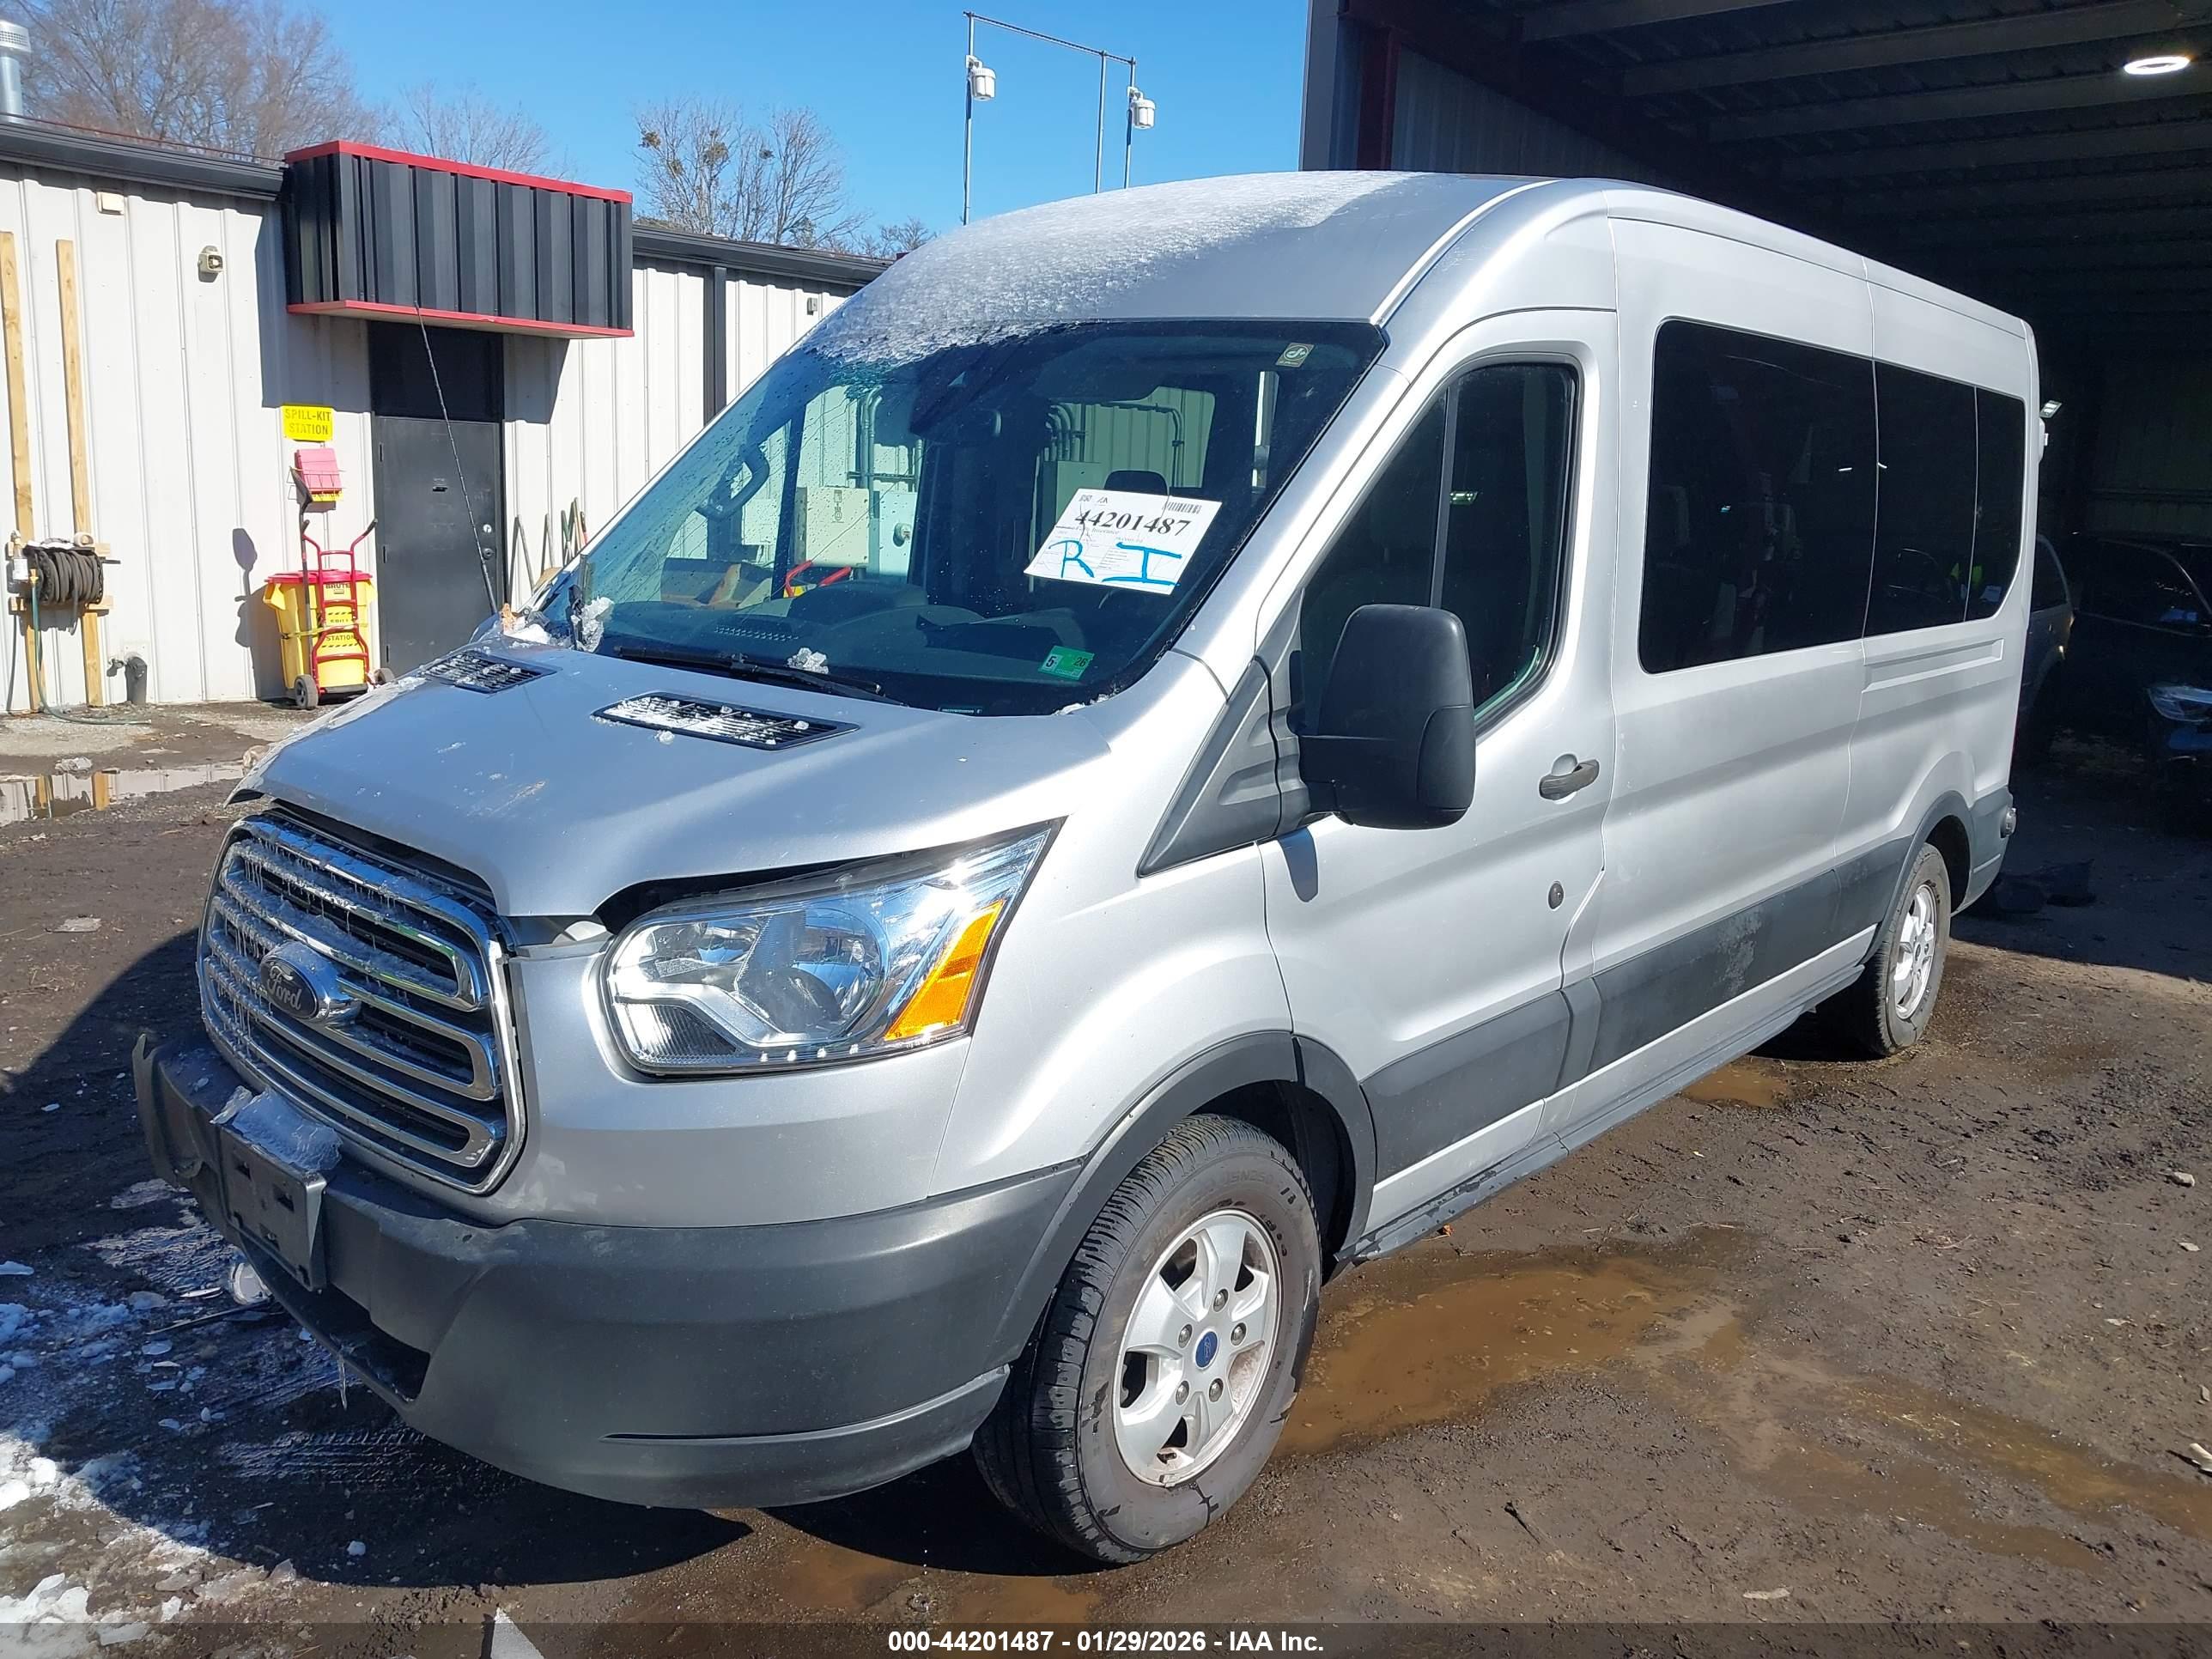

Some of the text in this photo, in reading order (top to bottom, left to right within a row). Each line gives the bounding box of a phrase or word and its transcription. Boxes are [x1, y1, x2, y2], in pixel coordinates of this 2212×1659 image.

[285, 409, 331, 422] SPILL-KIT
[289, 422, 329, 435] STATION
[1074, 509, 1192, 537] 44201487
[1048, 540, 1095, 579] R
[1073, 656, 1088, 667] 26
[266, 964, 302, 1011] Ford
